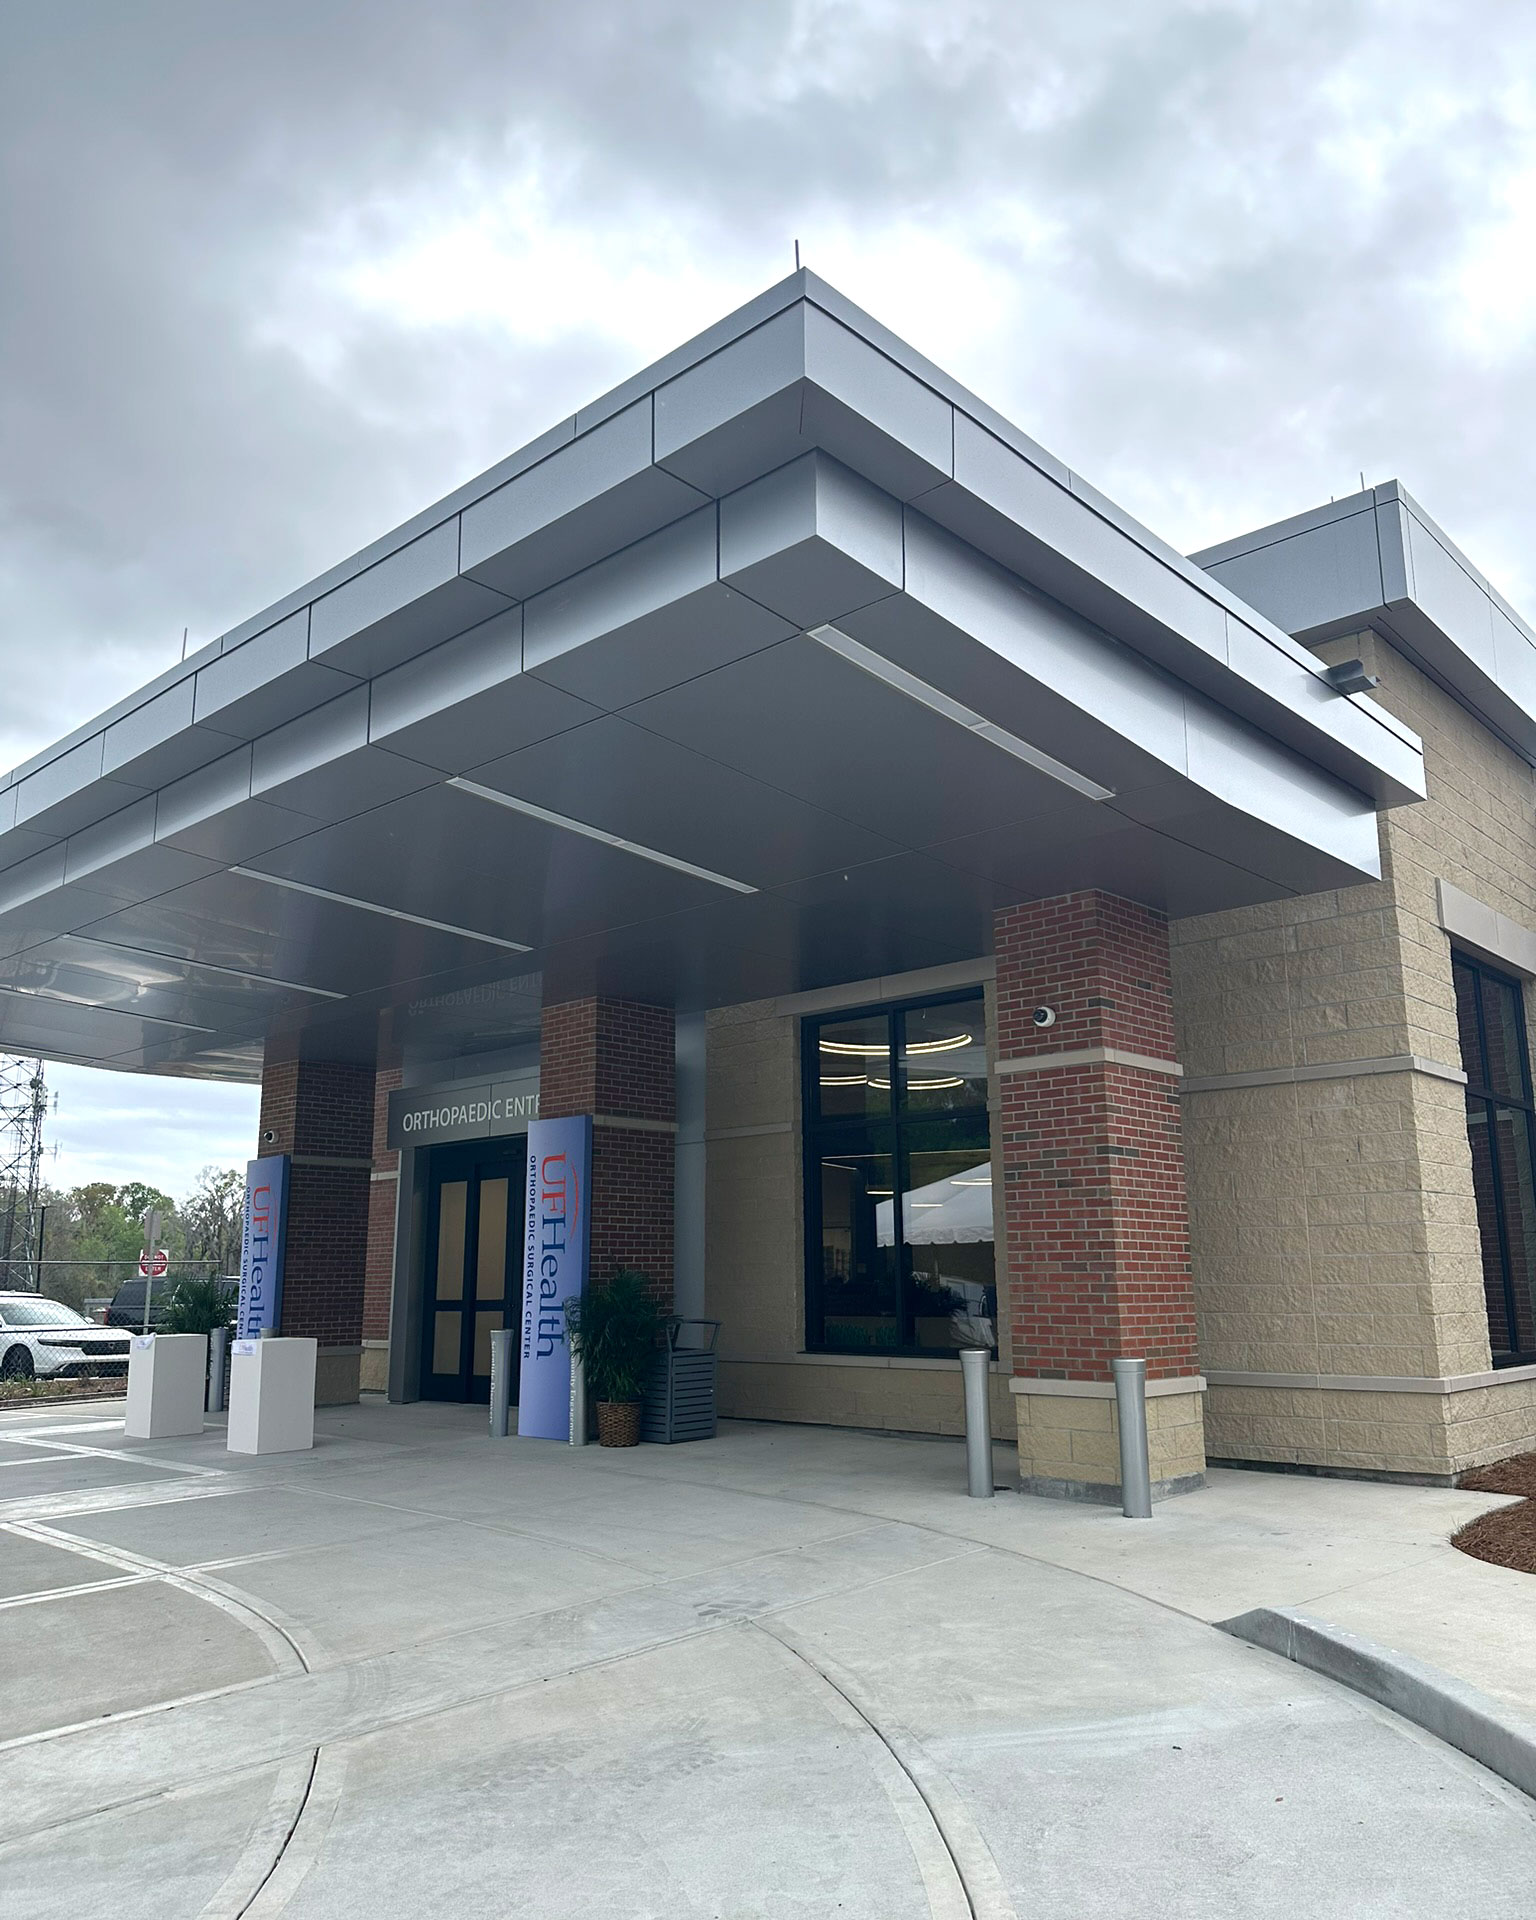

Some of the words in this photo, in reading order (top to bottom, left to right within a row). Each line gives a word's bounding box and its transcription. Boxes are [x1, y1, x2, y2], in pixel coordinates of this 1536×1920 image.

[402, 1099, 502, 1132] ORTHOPAEDIC
[243, 1186, 251, 1255] ORTHOPAEDIC
[528, 1155, 537, 1241] ORTHOPAEDIC
[240, 1259, 248, 1306] SURGICAL
[525, 1245, 535, 1307] SURGICAL
[523, 1310, 532, 1359] CENTER
